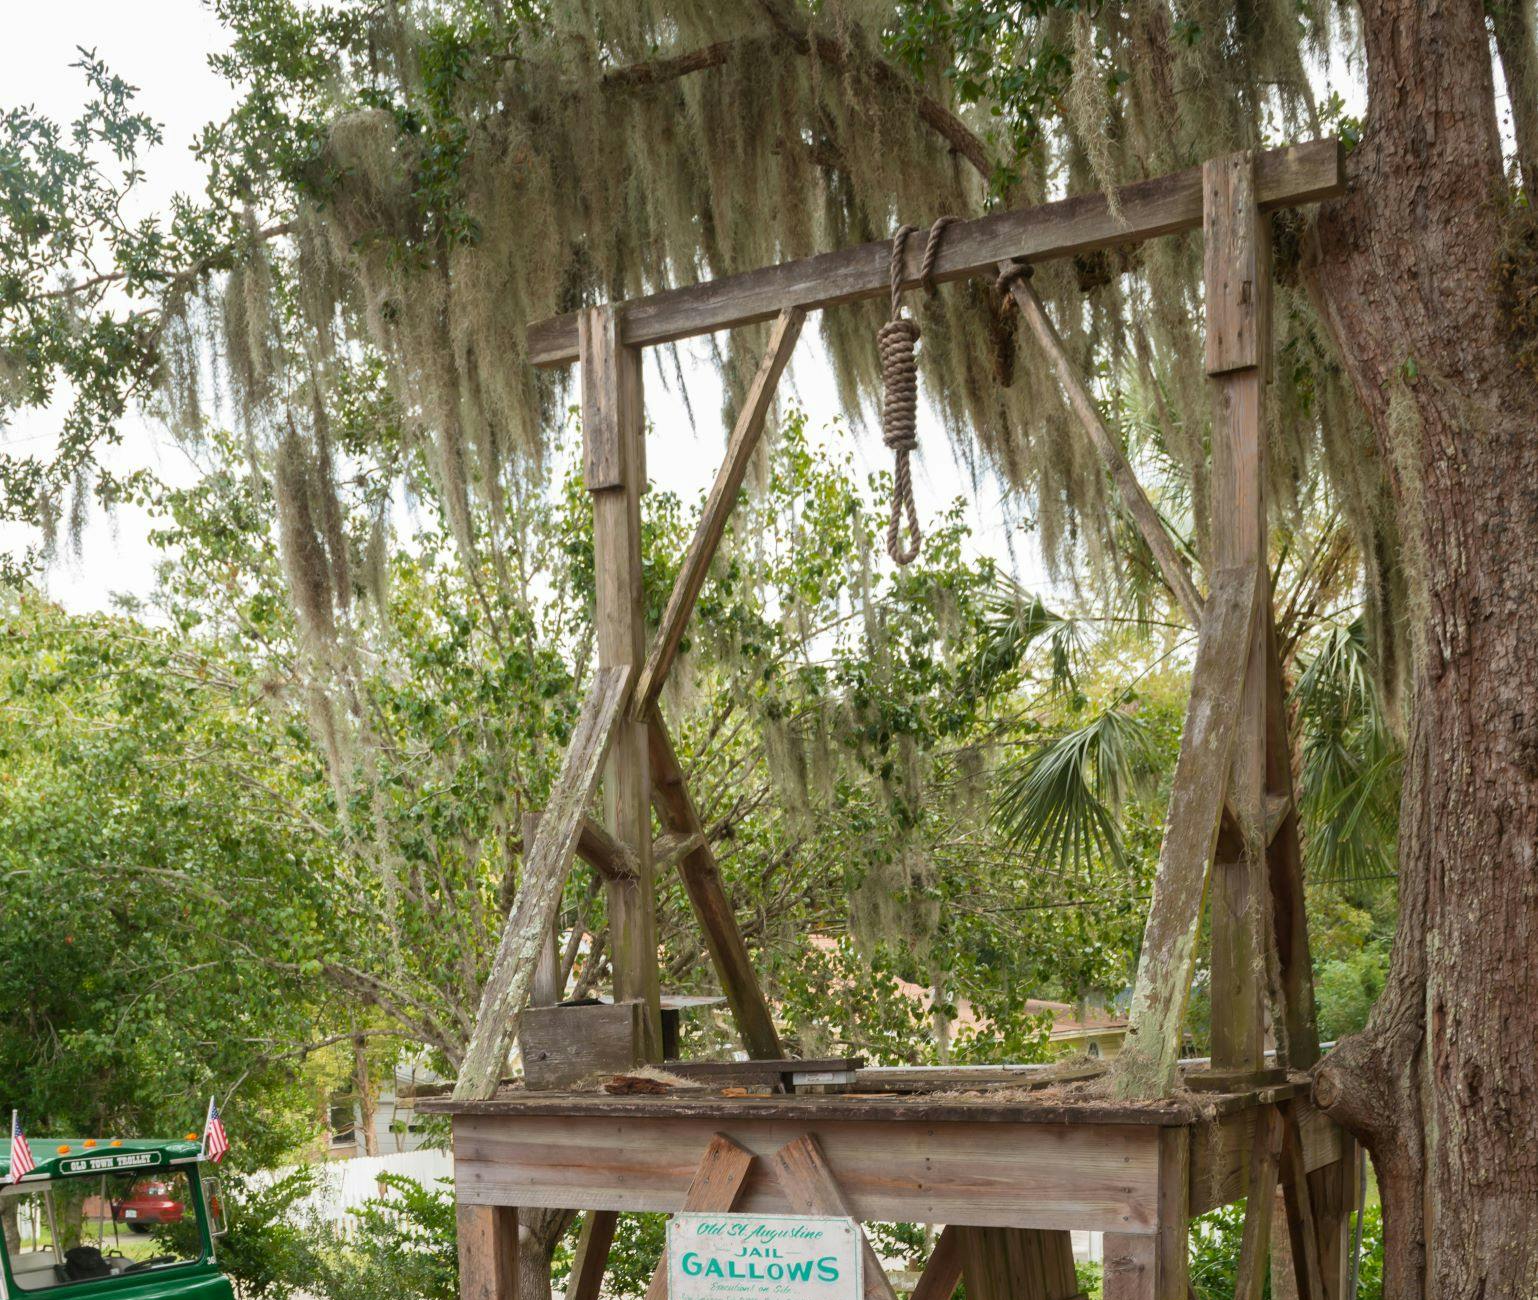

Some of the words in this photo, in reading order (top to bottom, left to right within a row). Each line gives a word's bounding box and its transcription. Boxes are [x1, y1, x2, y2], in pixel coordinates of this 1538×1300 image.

[70, 1161, 87, 1171] OLD
[90, 1158, 114, 1169] TOWN
[116, 1154, 152, 1166] TROLLEY
[697, 1222, 727, 1236] Old
[744, 1223, 825, 1244] Augustine
[734, 1247, 784, 1259] JAIL
[681, 1251, 840, 1283] GALLOWS
